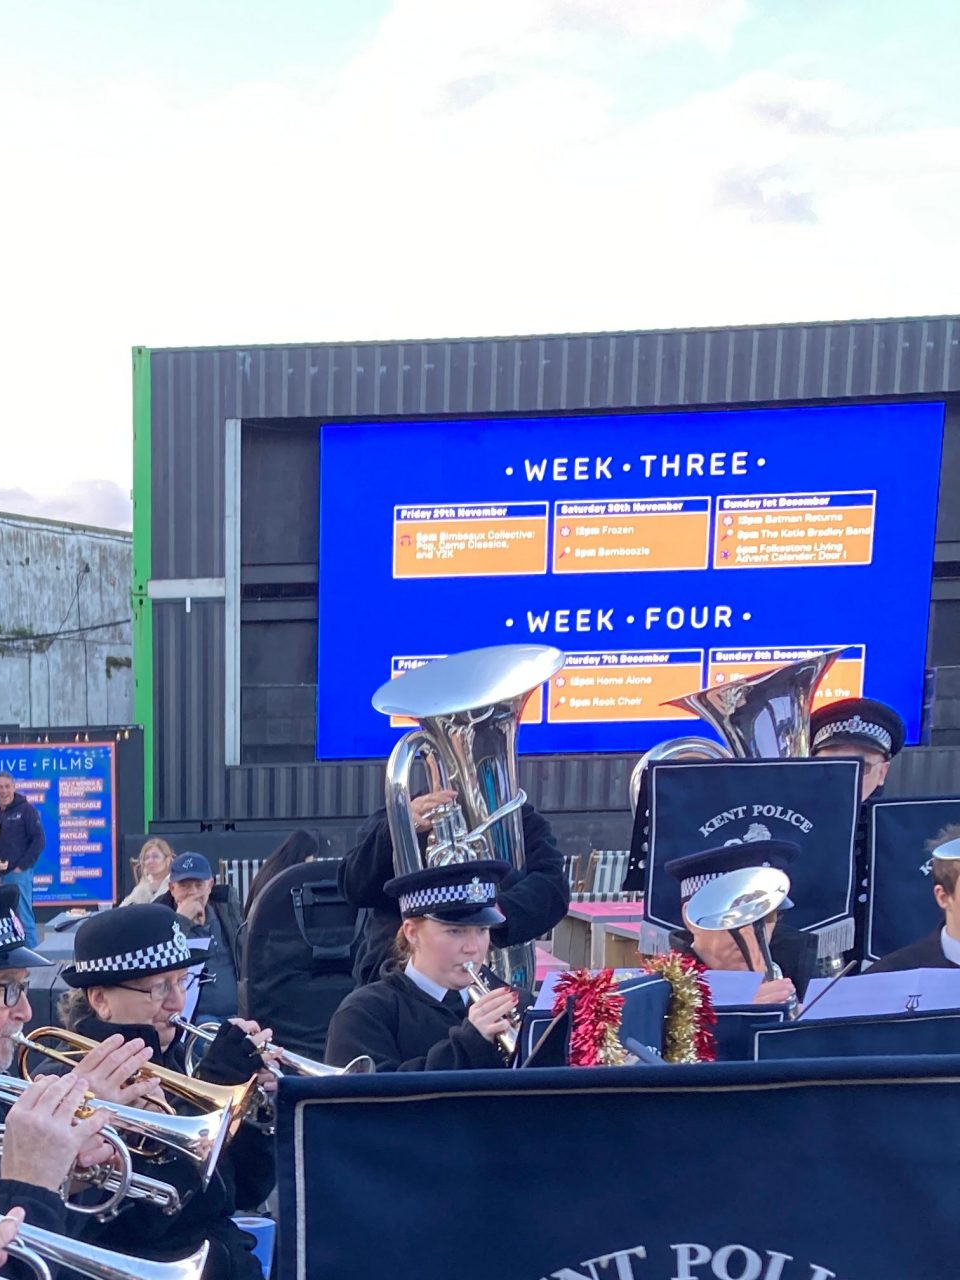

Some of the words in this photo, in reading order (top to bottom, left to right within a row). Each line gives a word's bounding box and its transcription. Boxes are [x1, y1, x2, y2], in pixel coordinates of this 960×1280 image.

[524, 457, 613, 482] WEEK
[640, 452, 748, 478] THREE
[561, 504, 606, 515] Saturday
[632, 502, 683, 512] November
[723, 499, 761, 510] Sunday
[779, 496, 830, 507] December
[400, 509, 431, 520] Friday
[458, 507, 507, 518] November
[765, 514, 802, 524] Batman
[804, 513, 843, 523] Returns
[602, 525, 634, 535] Frozen
[761, 529, 779, 538] The
[781, 528, 805, 537] Katie
[807, 527, 844, 538] Bradley
[846, 525, 871, 535] Band
[760, 543, 812, 553] Folkestone
[814, 542, 843, 552] Living
[736, 552, 769, 563] Advent
[818, 551, 841, 560] Door
[526, 608, 614, 633] WEEK
[645, 606, 732, 630] FOUR
[566, 655, 600, 666] turday
[602, 654, 618, 664] 7th
[620, 654, 669, 664] December
[716, 651, 753, 662] Sunday
[596, 676, 624, 686] Home
[626, 675, 652, 685] Alone
[834, 688, 850, 697] the
[619, 696, 642, 706] Choir
[42, 757, 94, 771] FILMS
[698, 806, 747, 839] KENT
[752, 804, 815, 834] POLICE
